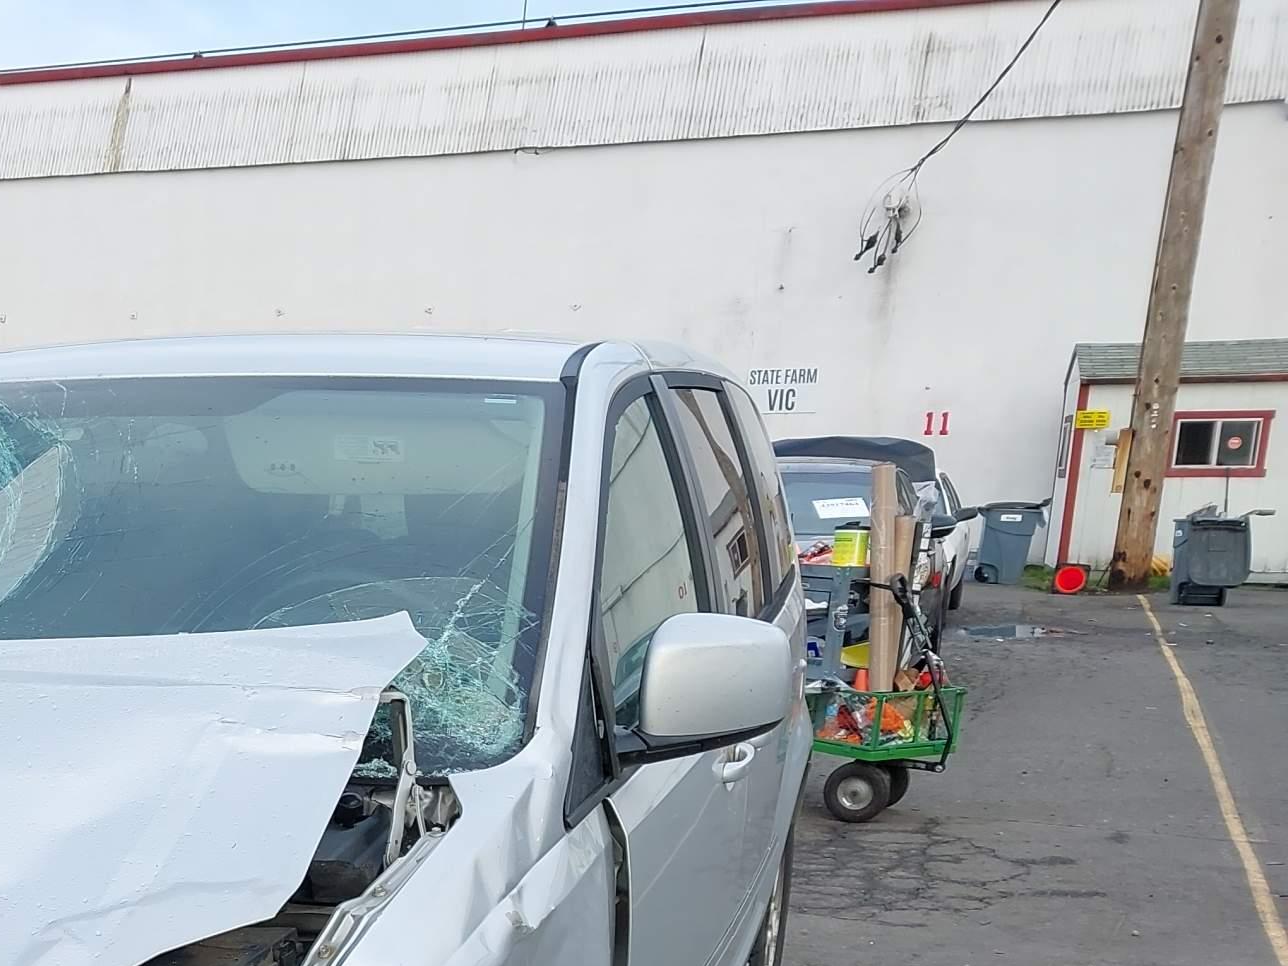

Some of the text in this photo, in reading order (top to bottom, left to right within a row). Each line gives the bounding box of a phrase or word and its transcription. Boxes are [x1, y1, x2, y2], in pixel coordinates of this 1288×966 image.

[749, 368, 818, 385] STATE FARM
[768, 388, 796, 411] VIC
[924, 411, 949, 435] 11
